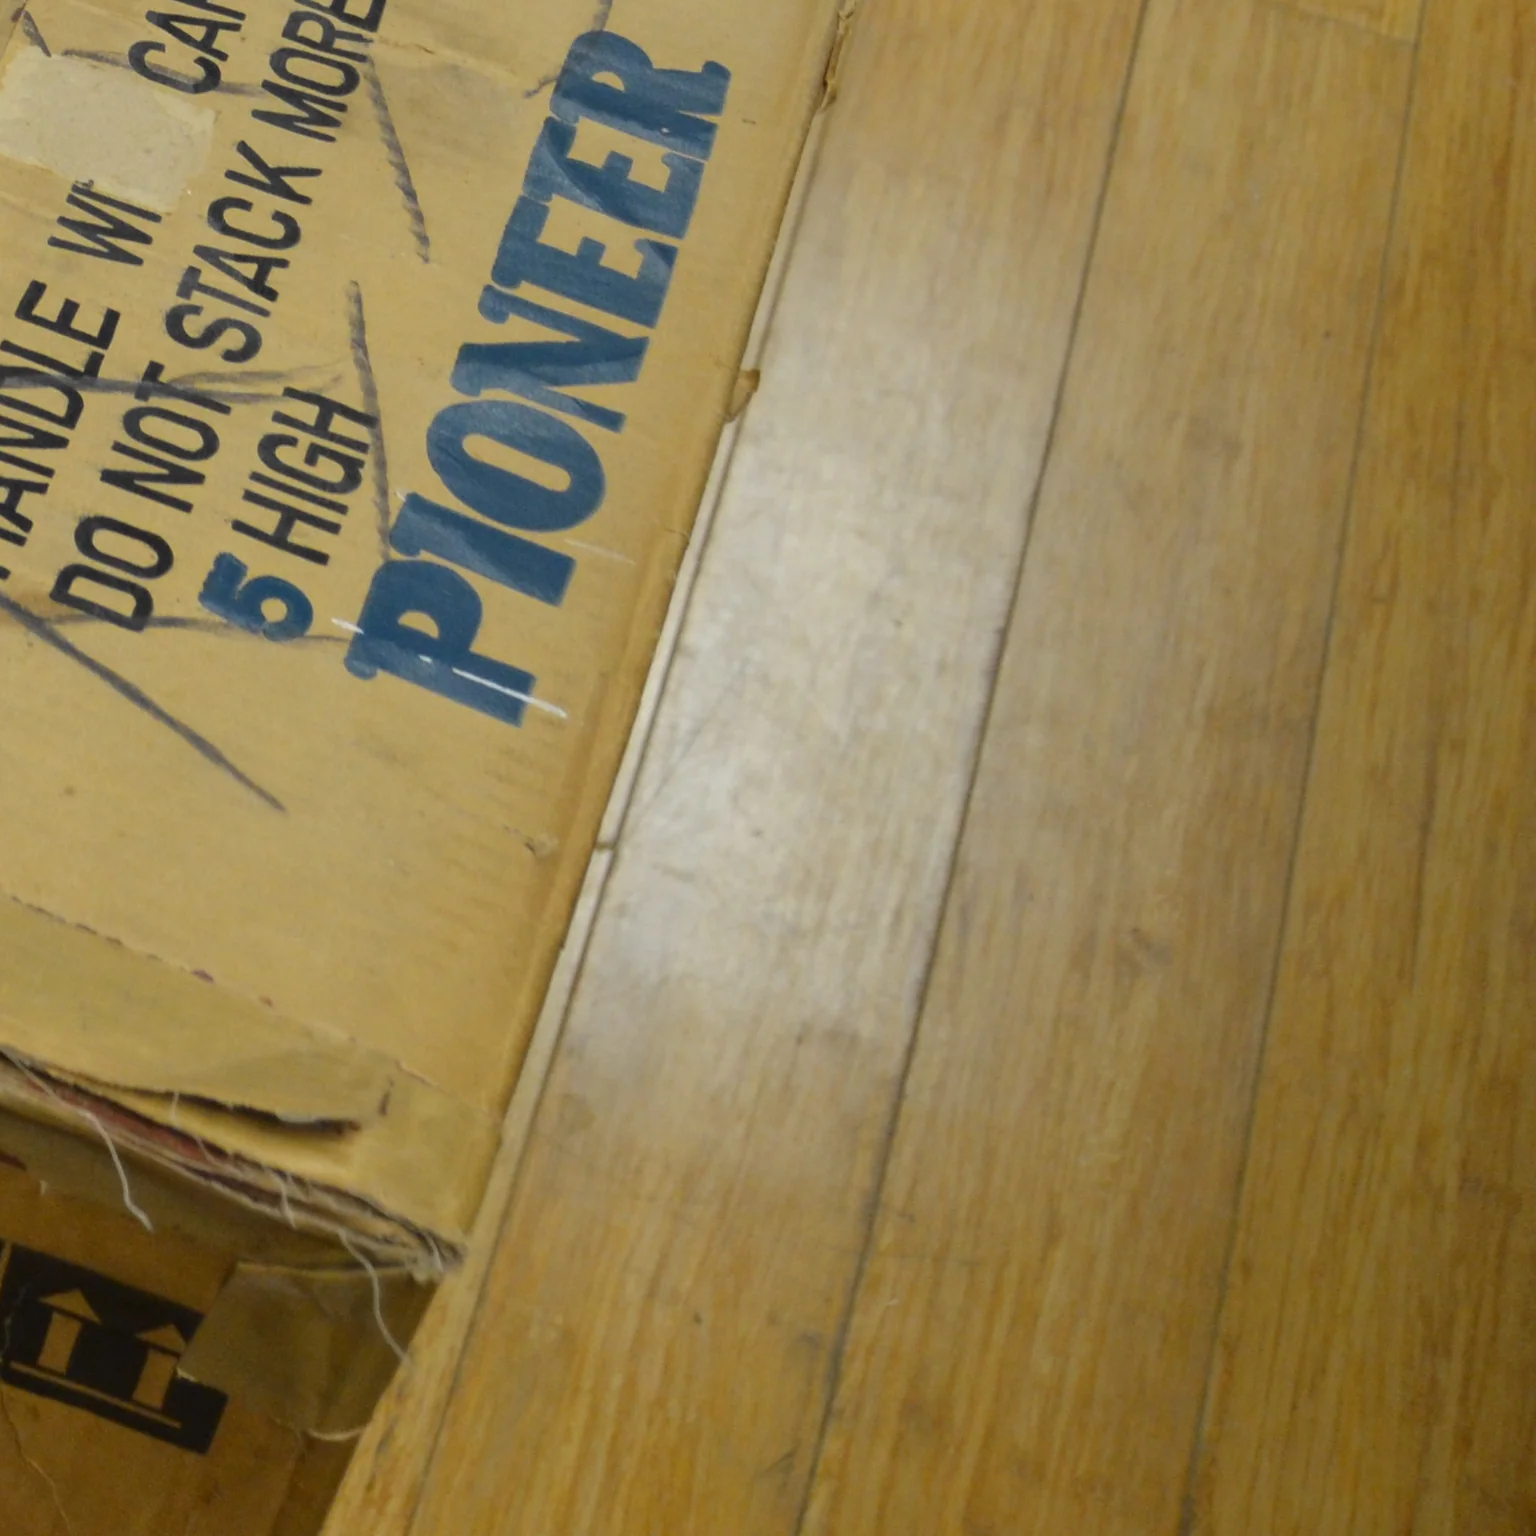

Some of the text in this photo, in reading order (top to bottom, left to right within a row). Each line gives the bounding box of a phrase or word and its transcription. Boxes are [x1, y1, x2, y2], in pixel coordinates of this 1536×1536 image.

[48, 180, 162, 266] WI
[166, 141, 321, 361] STACK
[101, 362, 230, 512] NOT
[345, 29, 731, 726] PIONEER
[50, 517, 173, 630] DO
[199, 388, 377, 642] 5 HIGH
